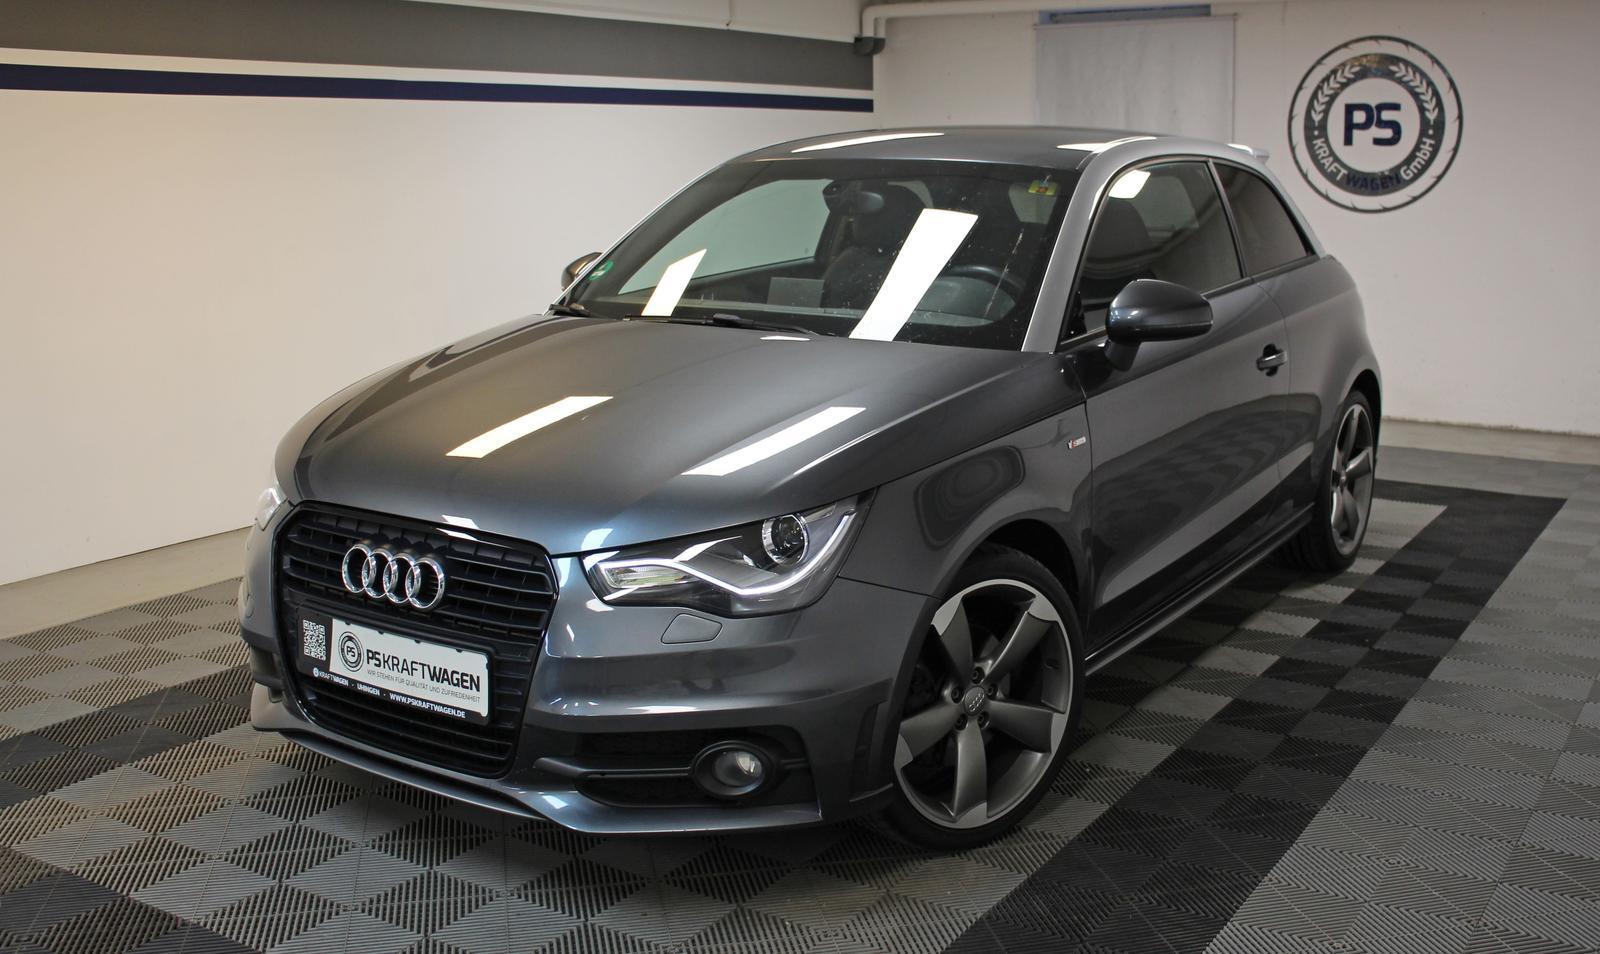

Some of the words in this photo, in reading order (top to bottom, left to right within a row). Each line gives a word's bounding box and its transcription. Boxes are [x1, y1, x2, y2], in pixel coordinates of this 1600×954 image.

[1344, 103, 1402, 146] PS
[1400, 137, 1435, 180] GmbH
[346, 645, 356, 657] PS
[376, 671, 395, 682] STEHEN
[429, 685, 440, 694] UND
[441, 688, 480, 703] ZUFRIEDENHEIT
[389, 693, 466, 719] WWW.PSKRAFTWAGEN.DE
